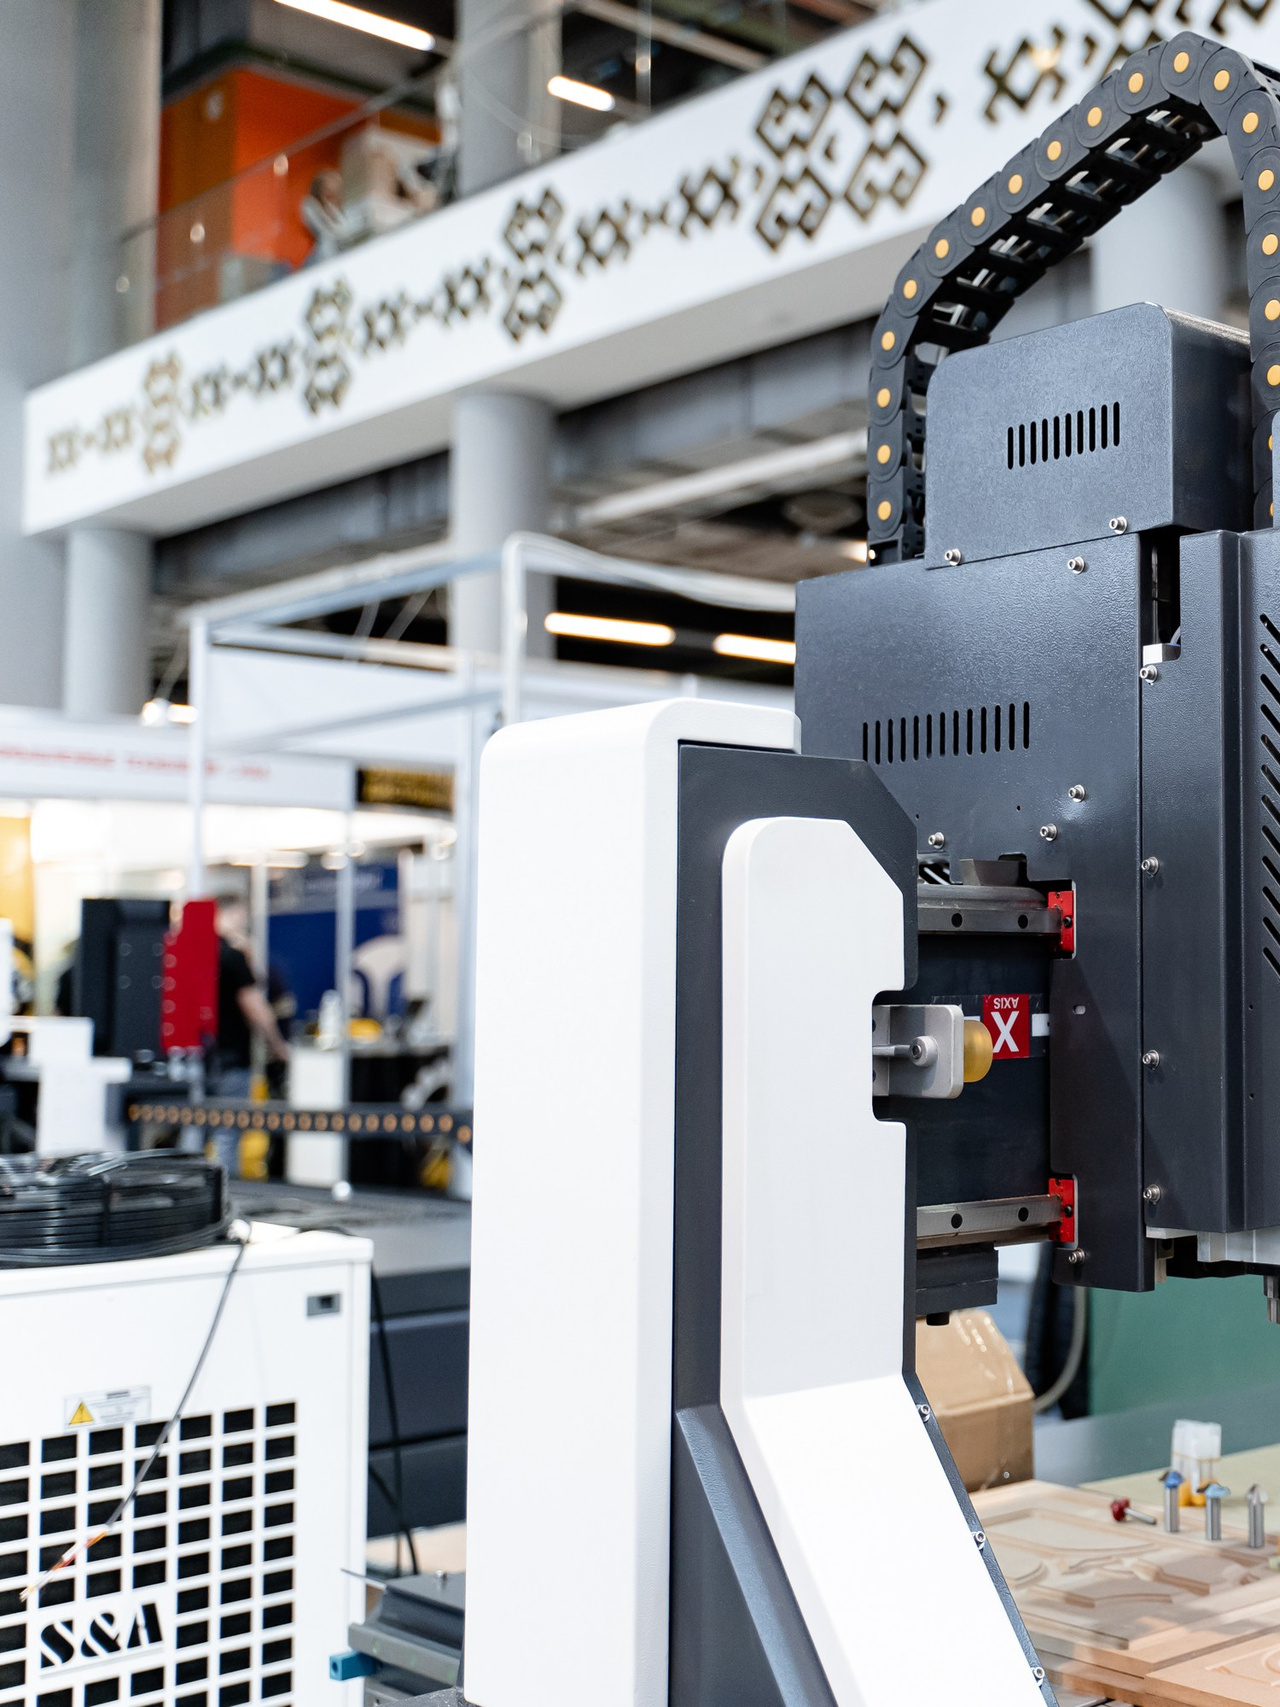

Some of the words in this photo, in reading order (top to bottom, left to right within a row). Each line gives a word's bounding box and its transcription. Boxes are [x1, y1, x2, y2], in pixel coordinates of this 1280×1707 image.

[993, 996, 1020, 1009] AXIS
[990, 1010, 1020, 1053] X
[41, 1602, 163, 1669] S&A
